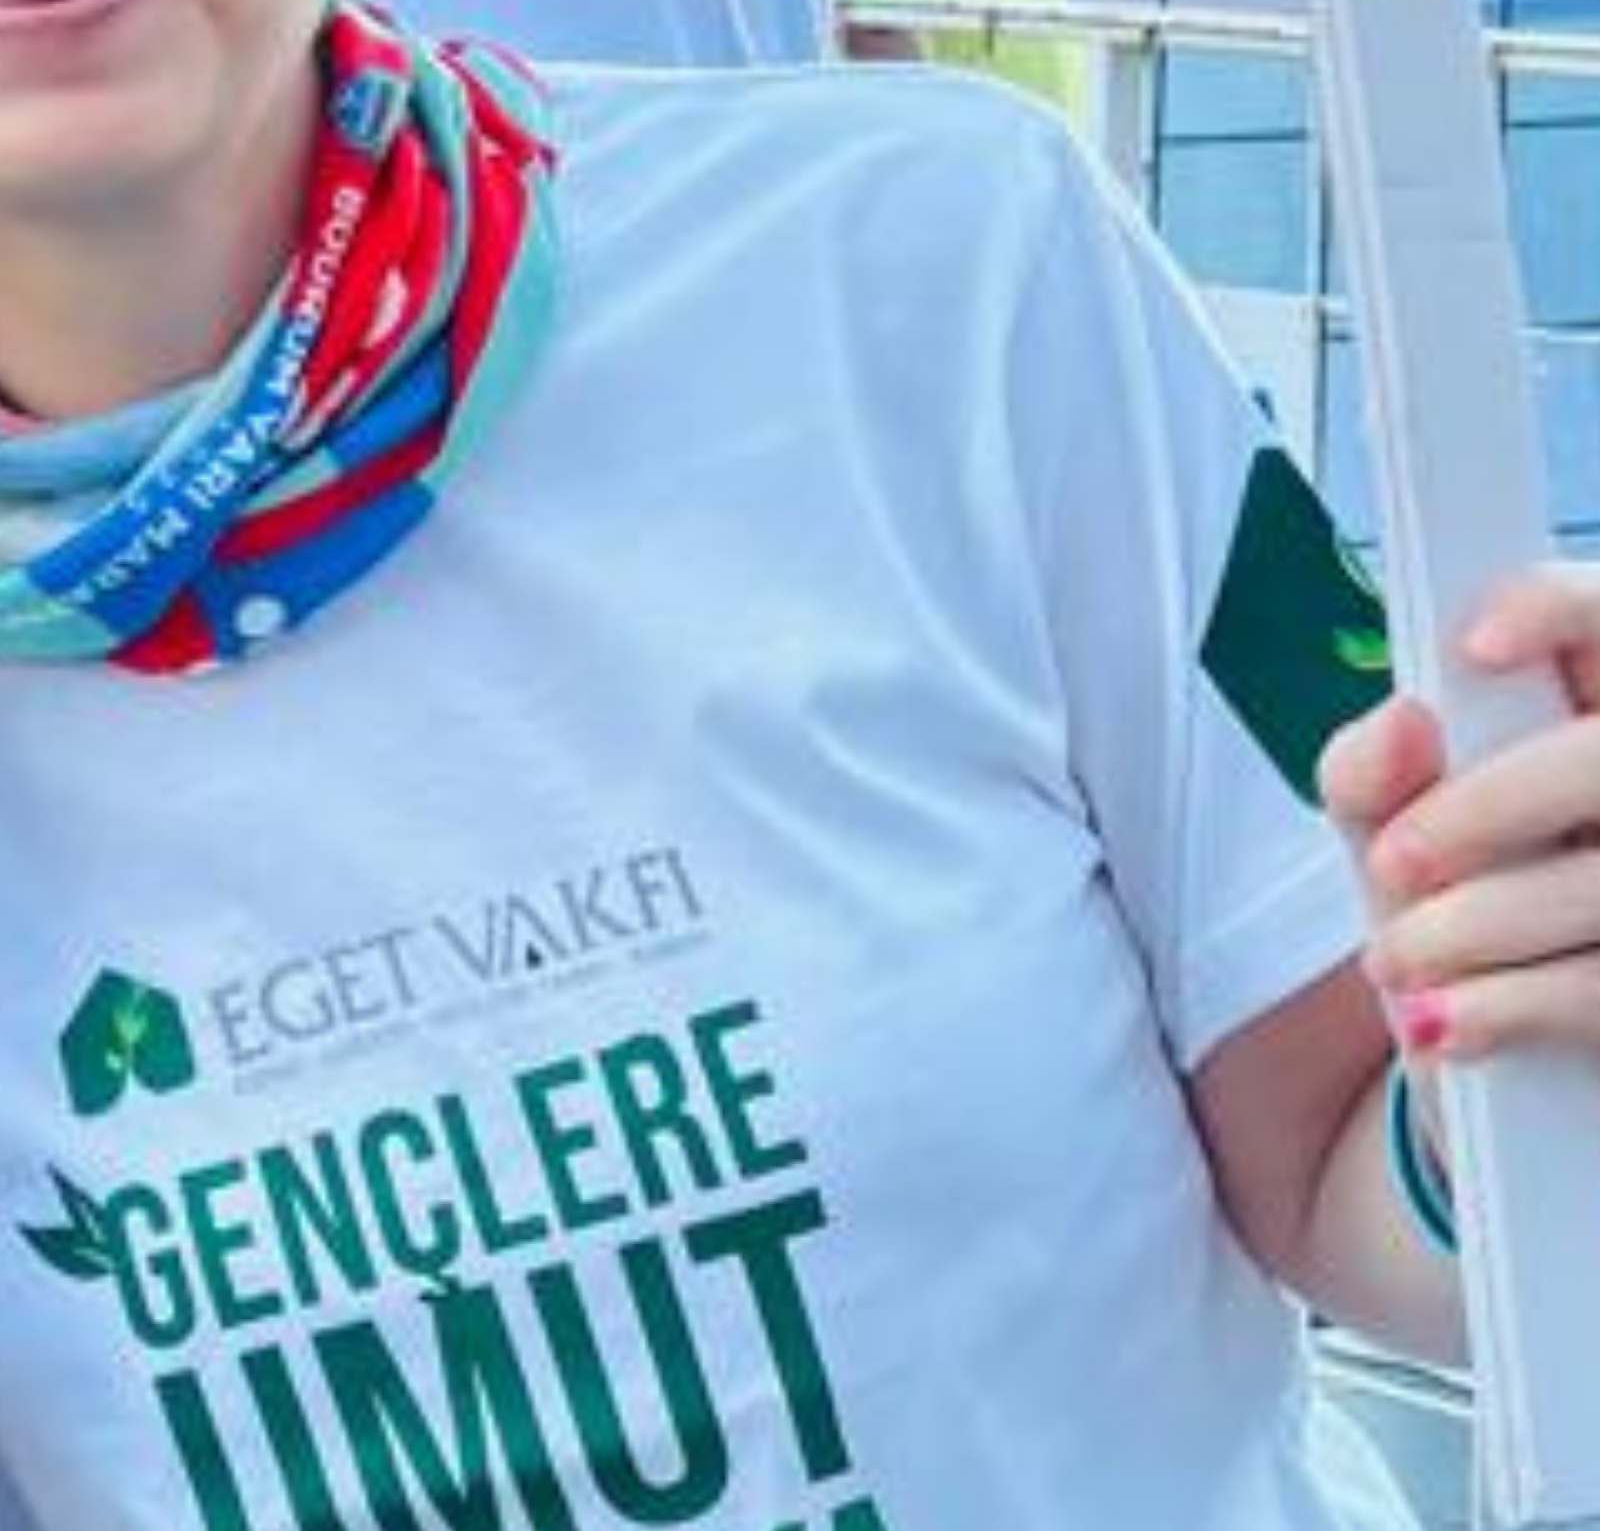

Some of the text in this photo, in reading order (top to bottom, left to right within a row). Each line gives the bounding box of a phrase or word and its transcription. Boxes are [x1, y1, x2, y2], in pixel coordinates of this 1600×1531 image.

[210, 929, 419, 1065] EGET
[433, 847, 704, 984] VAKFI
[100, 999, 809, 1351] GENÇLERE
